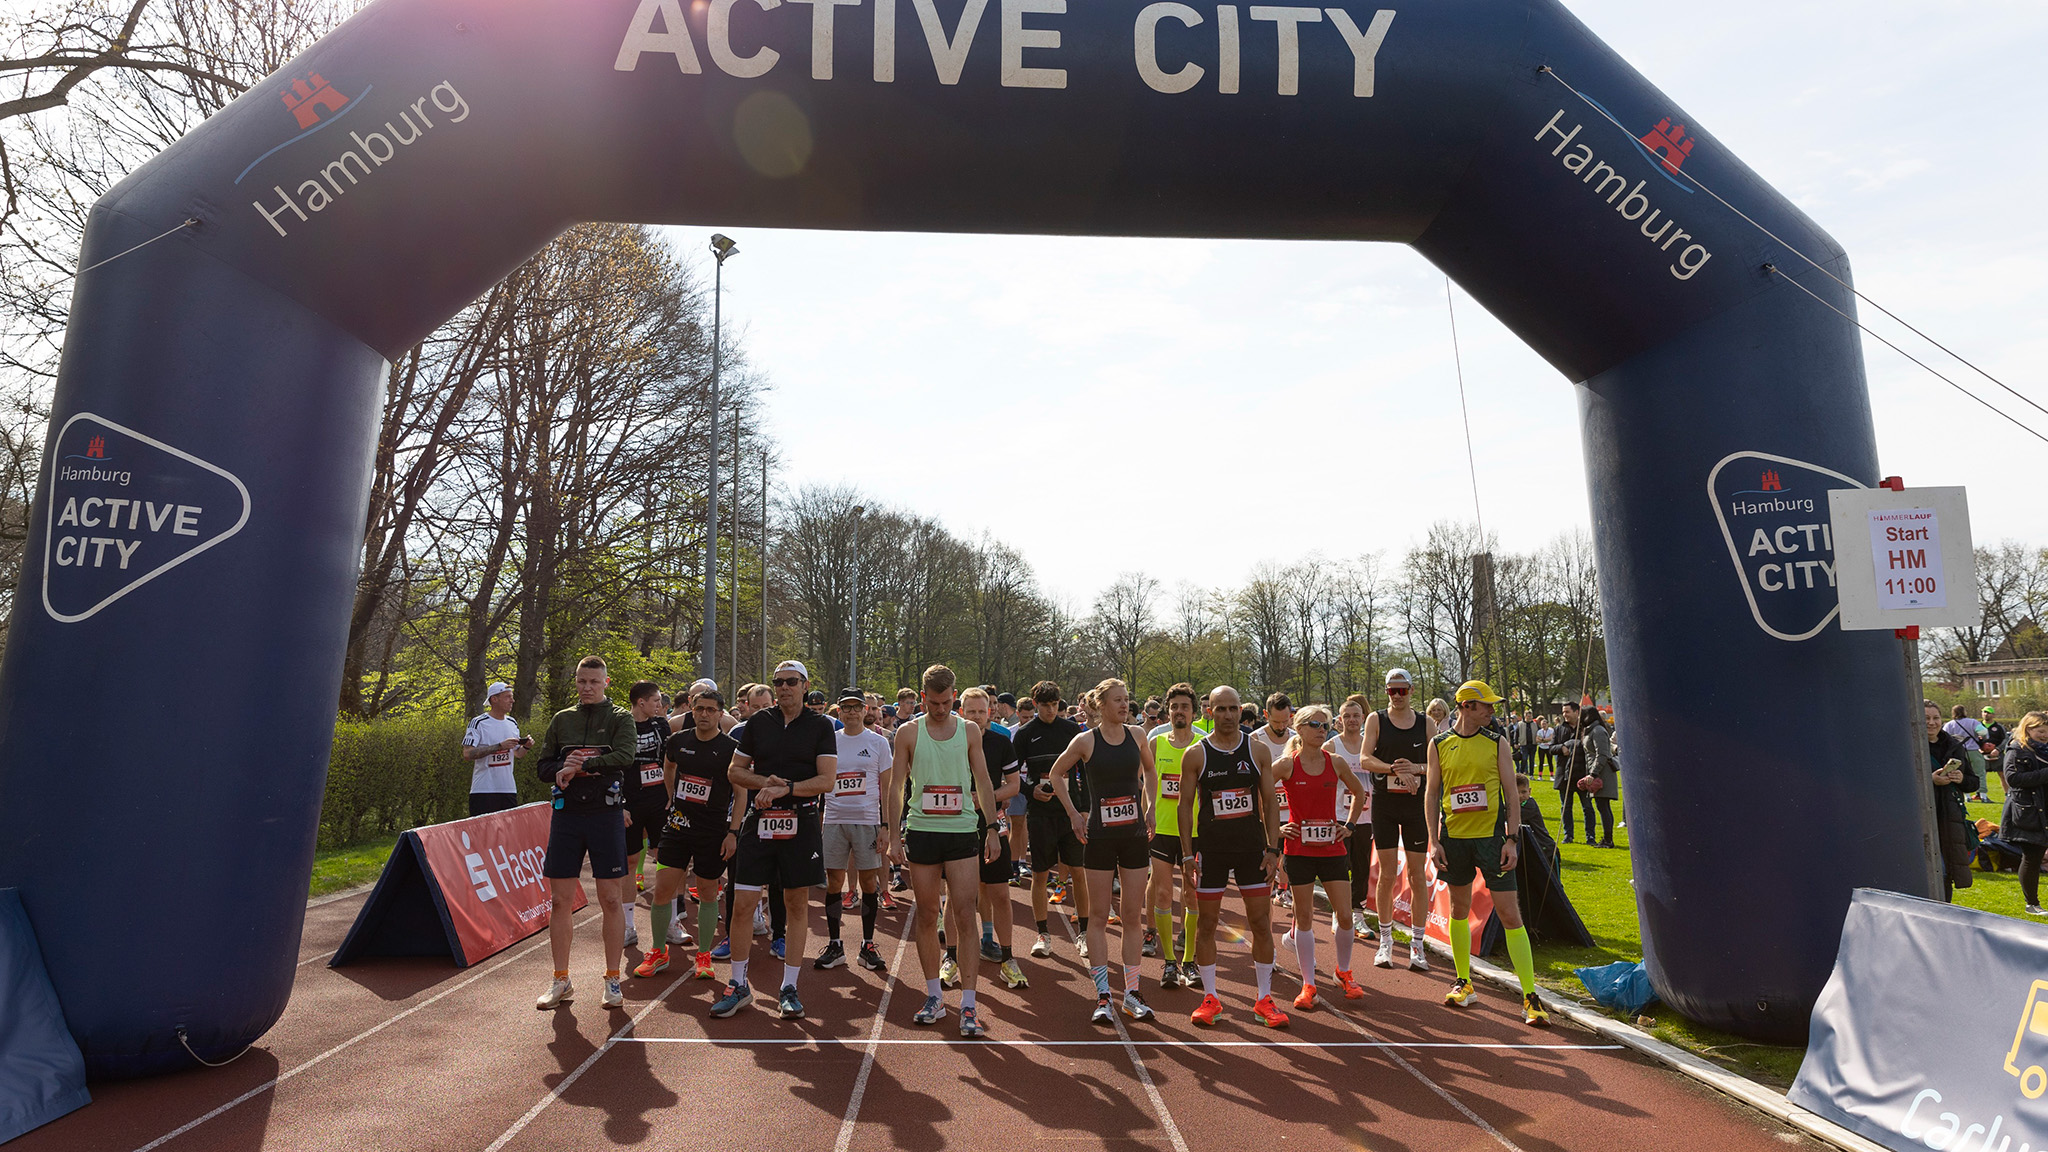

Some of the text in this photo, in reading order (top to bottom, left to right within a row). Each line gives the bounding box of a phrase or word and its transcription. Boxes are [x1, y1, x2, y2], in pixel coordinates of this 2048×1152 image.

[613, 0, 1397, 98] ACTIVE CITY
[252, 76, 471, 238] Hamburg
[1533, 108, 1712, 281] Hamburg
[60, 465, 132, 487] Hamburg
[1732, 497, 1814, 516] Hamburg
[57, 496, 203, 537] ACTIVE
[1748, 523, 1833, 557] ACTI
[1886, 526, 1929, 542] Start
[55, 536, 142, 570] CITY
[1888, 549, 1927, 570] HM
[1885, 577, 1936, 595] 11:00
[492, 753, 510, 762] 1923
[681, 781, 707, 797] 1958
[837, 778, 863, 790] 1937
[933, 793, 948, 806] 11
[1217, 796, 1249, 811] 1926
[1456, 791, 1480, 805] 633
[1105, 804, 1135, 818] 1948
[762, 818, 793, 831] 1049
[1306, 826, 1333, 838] 1151
